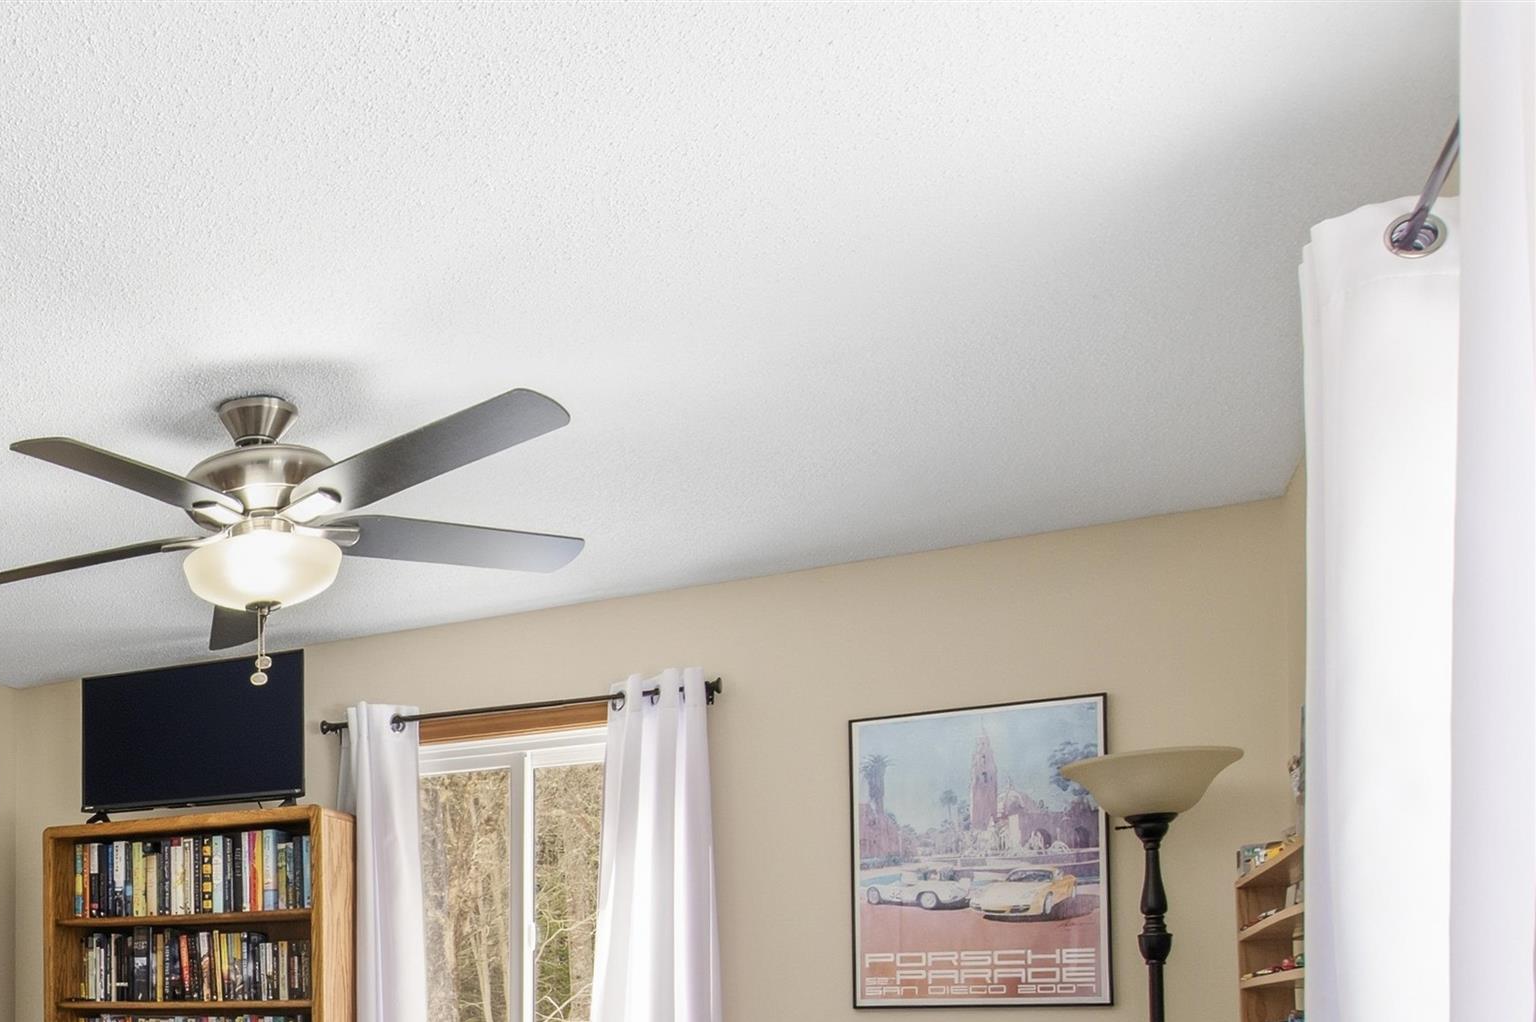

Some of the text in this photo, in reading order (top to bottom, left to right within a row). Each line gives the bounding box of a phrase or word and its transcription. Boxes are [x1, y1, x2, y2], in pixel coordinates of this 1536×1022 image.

[865, 948, 1096, 967] PORSCHE
[896, 966, 1096, 985] PARADE
[865, 982, 1097, 996] SAN DIEGO 2007
